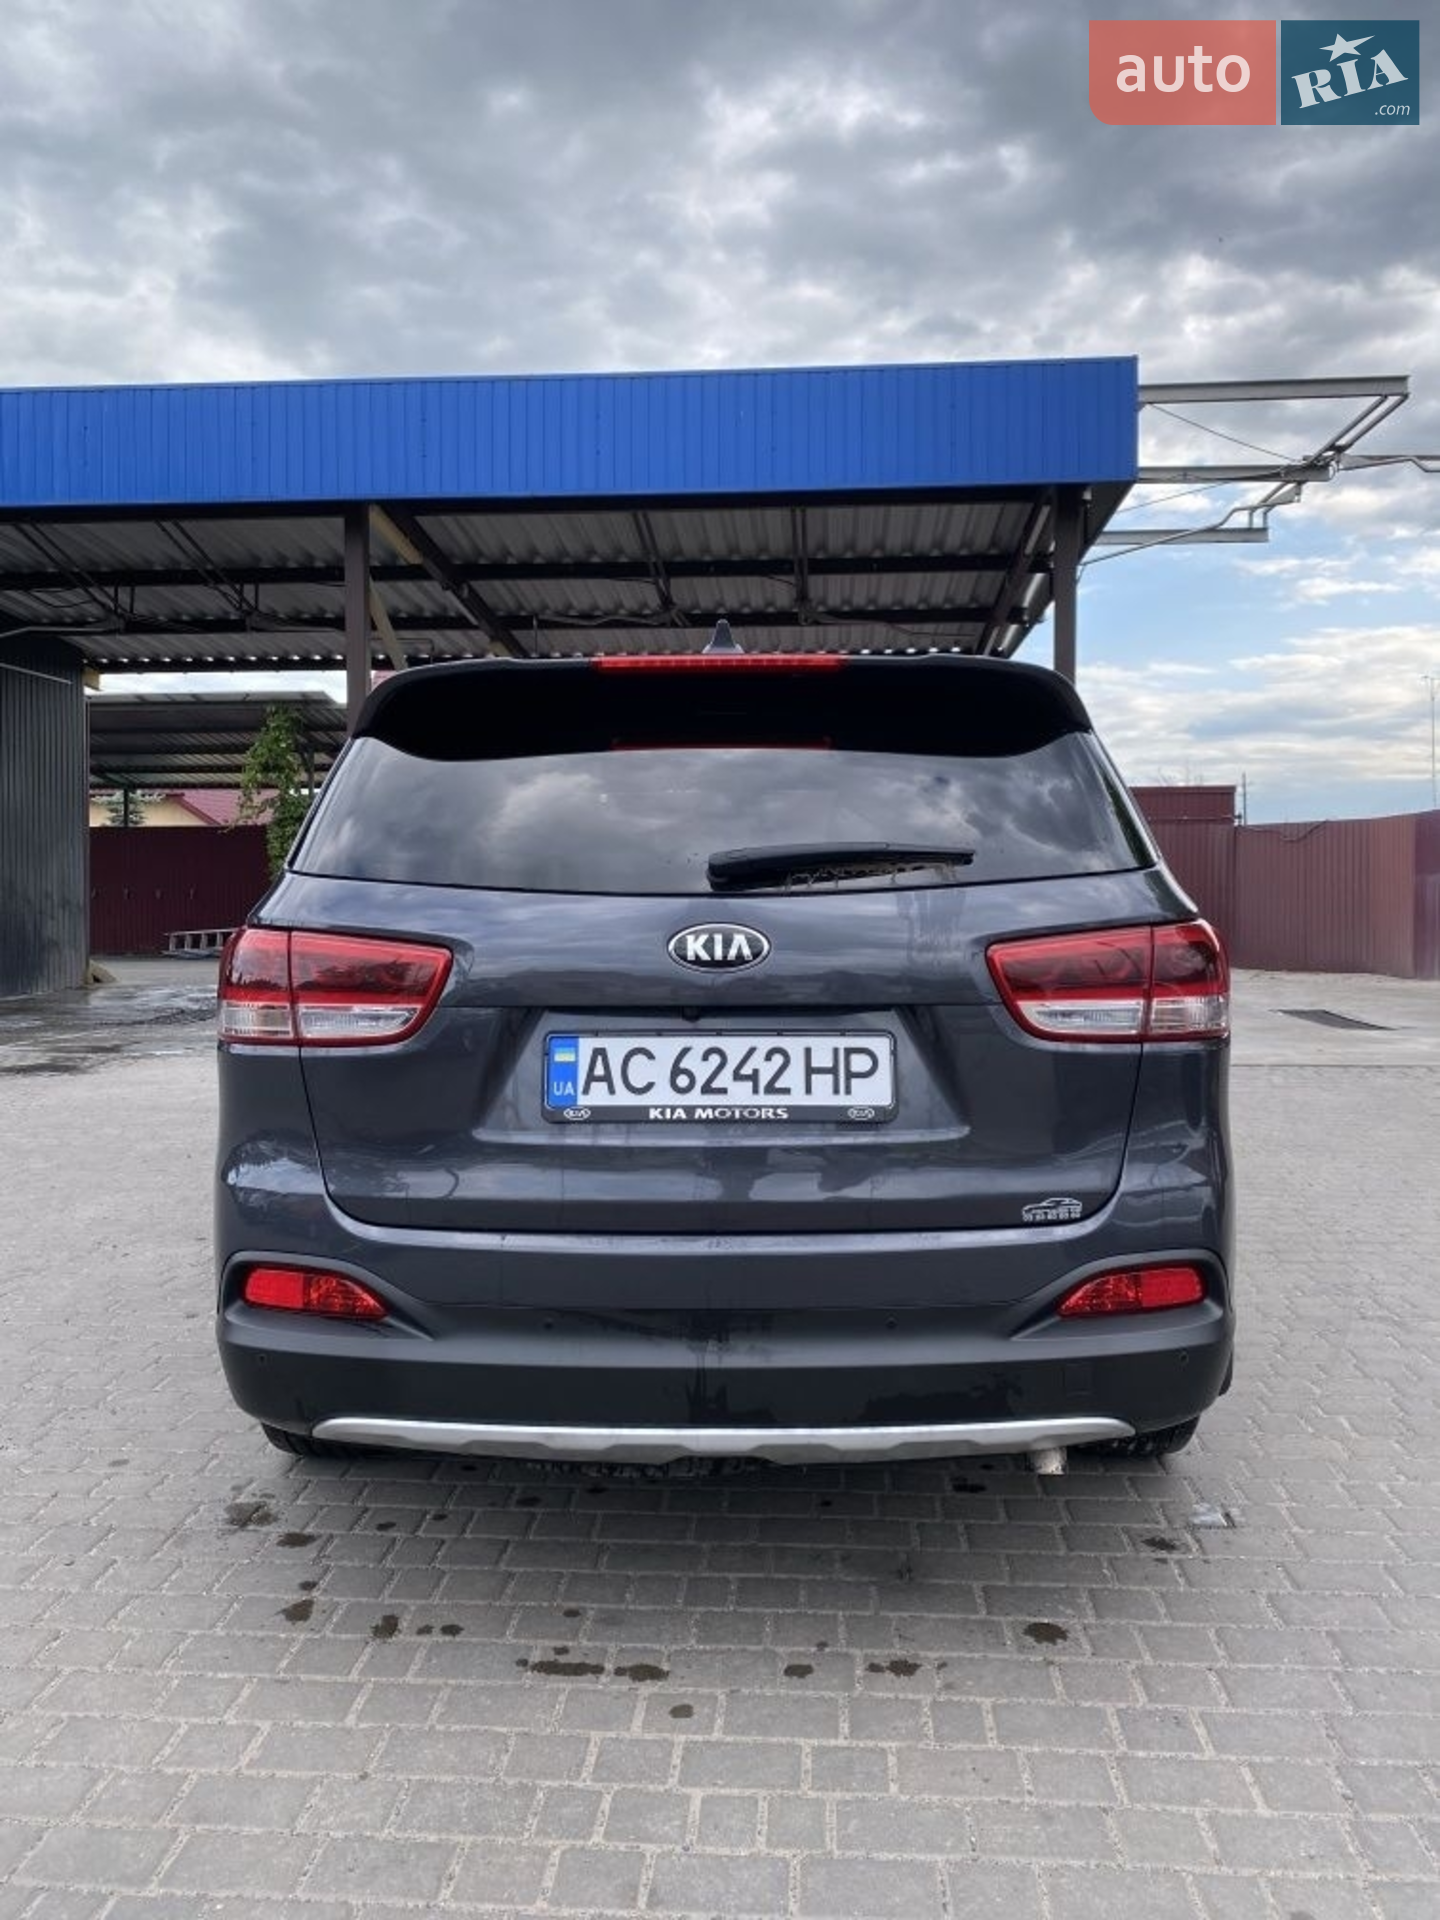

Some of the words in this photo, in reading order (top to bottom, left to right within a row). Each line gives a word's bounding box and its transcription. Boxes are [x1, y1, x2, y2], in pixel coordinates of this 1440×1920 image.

[685, 933, 753, 961] KIA
[581, 1047, 656, 1096] AC
[669, 1047, 791, 1096] 6242
[804, 1047, 879, 1096] HP
[553, 1081, 575, 1096] UA
[649, 1107, 687, 1119] KIA
[694, 1107, 789, 1119] MOTORS
